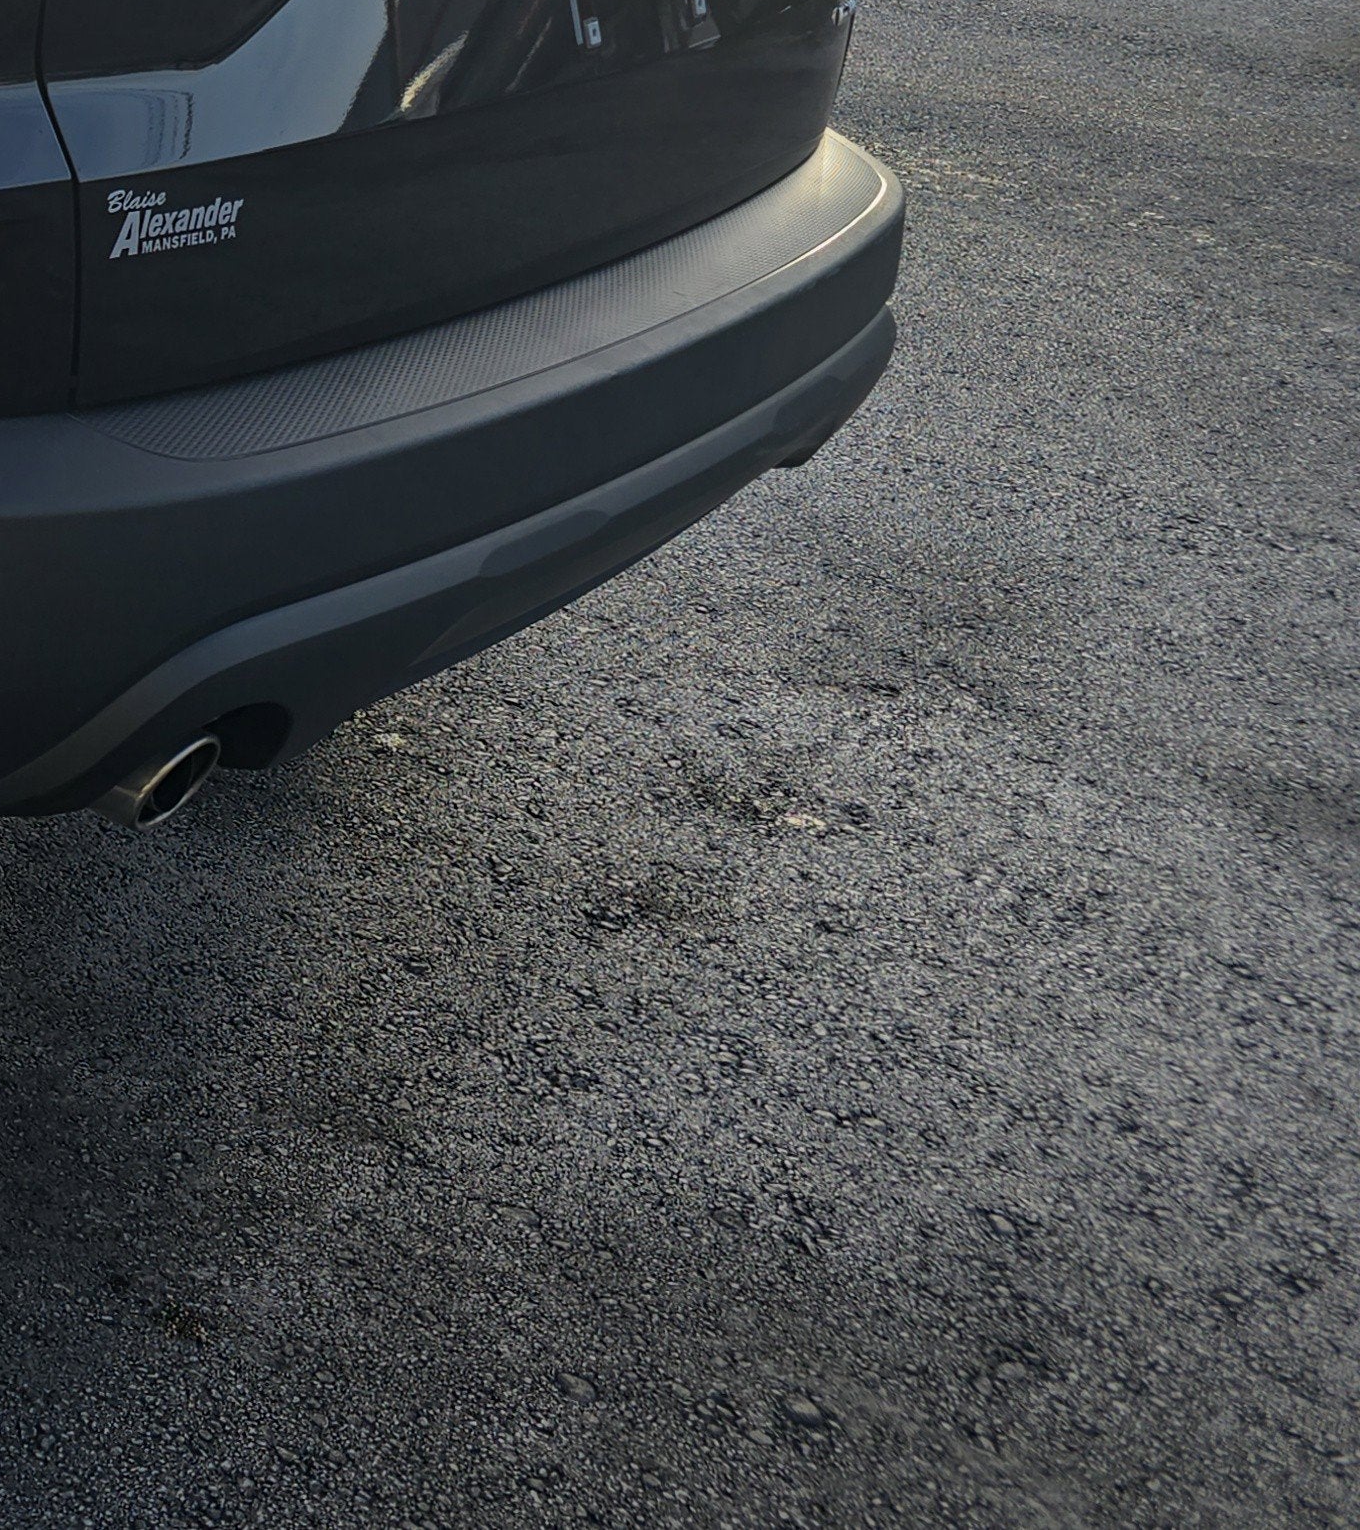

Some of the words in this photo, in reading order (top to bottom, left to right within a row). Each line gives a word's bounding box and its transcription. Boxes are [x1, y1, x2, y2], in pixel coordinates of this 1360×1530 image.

[106, 188, 167, 214] Blaise
[108, 196, 245, 260] Alexander
[141, 231, 217, 254] MANSFIELD,
[220, 225, 237, 240] PA
